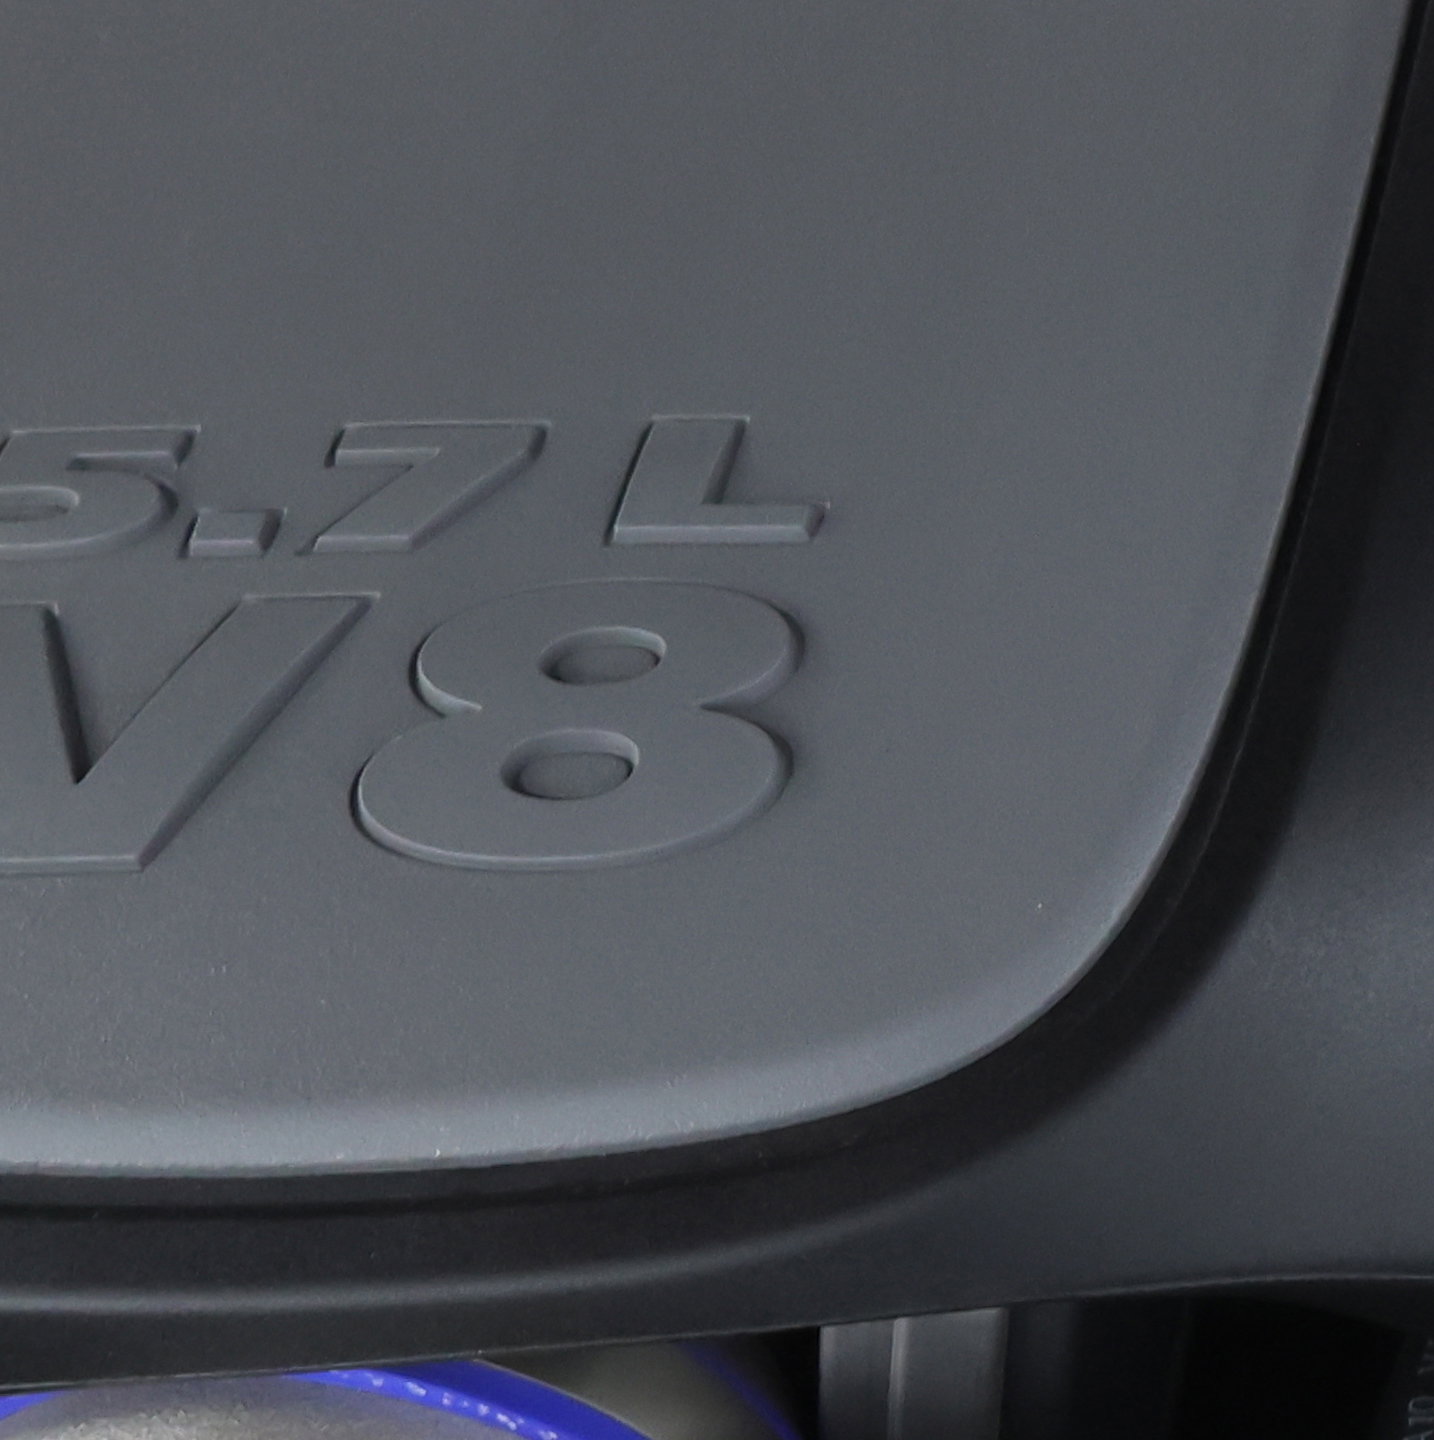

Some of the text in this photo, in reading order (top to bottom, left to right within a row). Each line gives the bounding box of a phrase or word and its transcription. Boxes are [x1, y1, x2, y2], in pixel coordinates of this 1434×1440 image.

[0, 413, 830, 558] 5.7 L
[0, 574, 803, 872] V8
